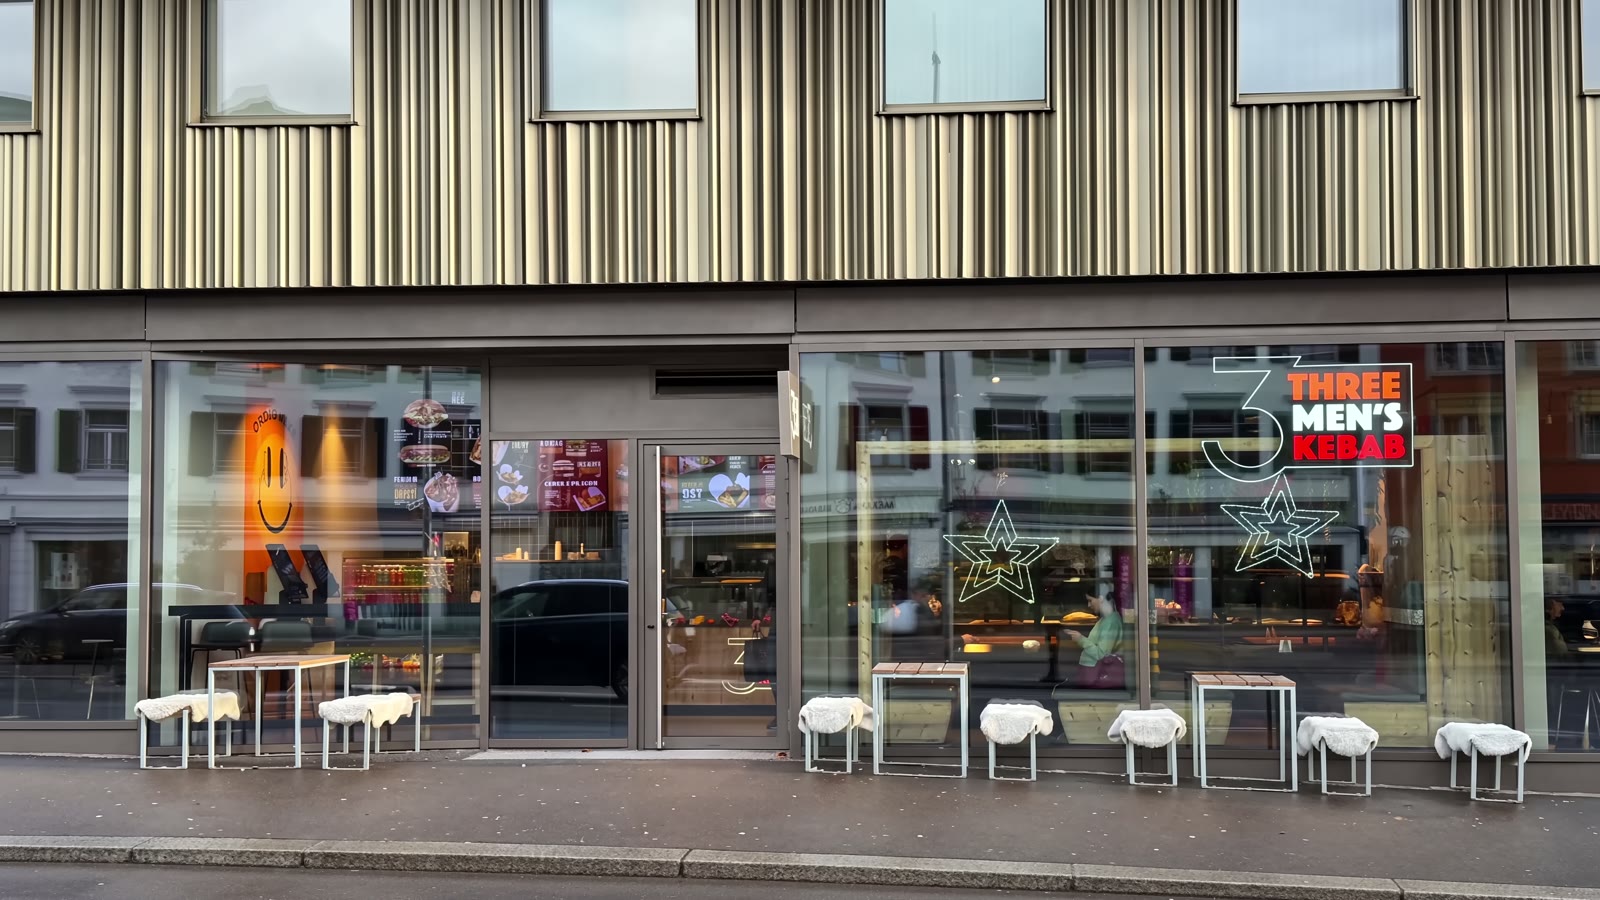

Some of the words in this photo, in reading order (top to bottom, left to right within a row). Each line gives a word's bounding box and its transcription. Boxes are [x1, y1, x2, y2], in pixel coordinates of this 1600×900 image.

[1287, 371, 1400, 400] THREE
[1292, 402, 1404, 432] MEN'S
[1293, 433, 1406, 460] KEBAB
